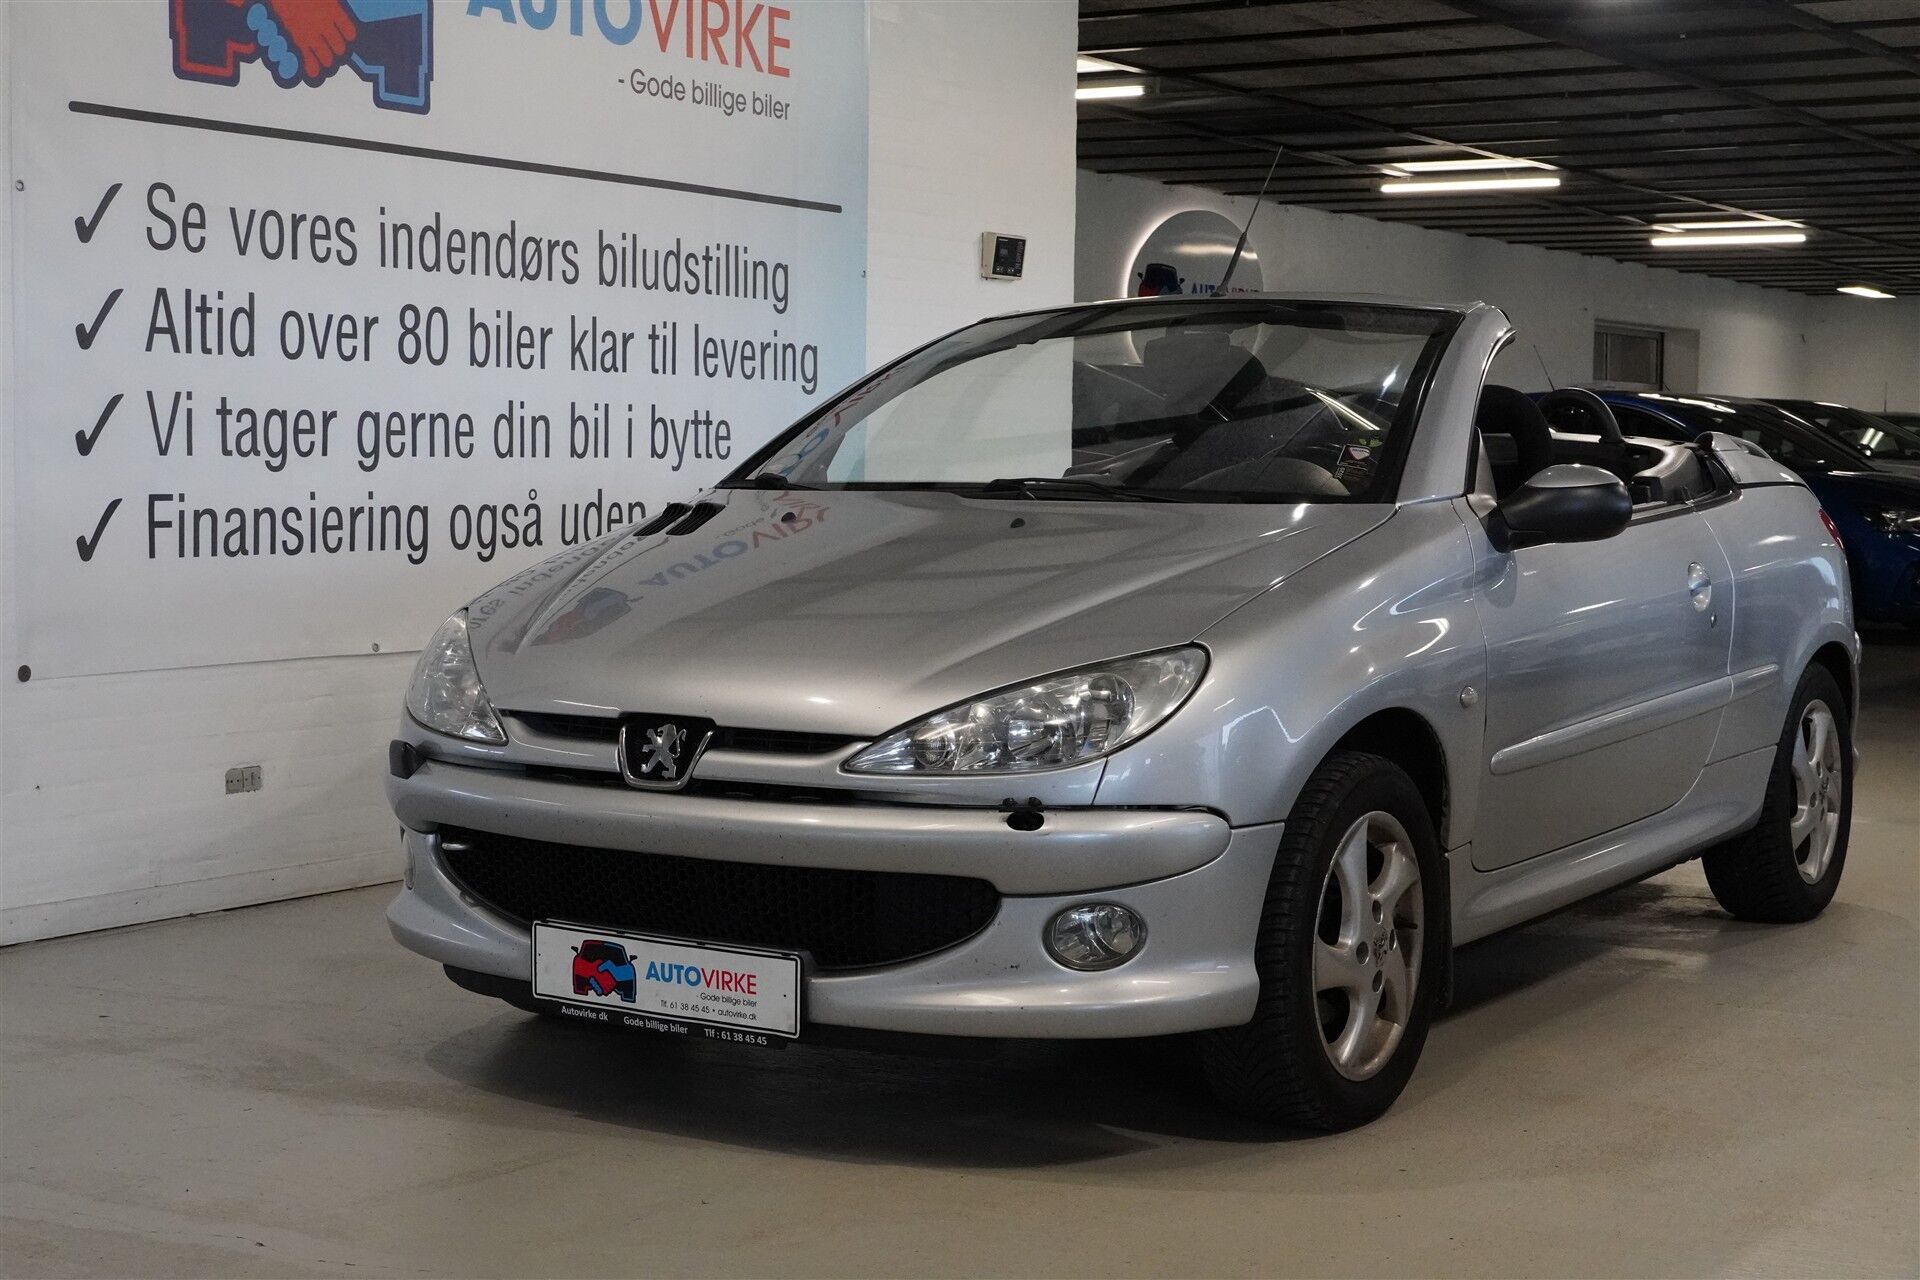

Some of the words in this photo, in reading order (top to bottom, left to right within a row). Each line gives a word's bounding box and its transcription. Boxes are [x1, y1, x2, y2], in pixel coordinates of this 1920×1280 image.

[466, 0, 791, 78] OVIRKE
[631, 69, 686, 101] Gode
[692, 80, 747, 117] billige
[752, 91, 791, 120] biler
[146, 182, 207, 253] Se
[230, 204, 358, 267] vores
[379, 206, 580, 285] indendørs
[598, 229, 789, 315] biludstilling
[145, 288, 255, 357] Altid
[280, 311, 379, 362] over
[397, 304, 449, 366] 80
[469, 314, 553, 370] biler
[570, 315, 635, 374] klar
[647, 321, 677, 376] til
[694, 324, 818, 395] levering
[146, 391, 193, 457] Vi
[215, 396, 337, 473] tager
[357, 410, 475, 473] gerne
[493, 400, 551, 460] din
[569, 402, 610, 460] bil
[627, 403, 634, 459] i
[650, 411, 732, 472] bytte
[147, 491, 429, 565] Finansiering
[449, 488, 543, 563] også
[645, 961, 757, 995] AUTOVIRKE
[561, 1005, 597, 1020] Autovirke
[680, 1003, 689, 1011] 38
[691, 1004, 700, 1012] 45
[700, 992, 721, 1003] Gode
[721, 995, 741, 1007] billige
[742, 998, 757, 1007] biler
[623, 1015, 644, 1028] Gode
[645, 1019, 669, 1032] billige
[670, 1023, 688, 1034] biler
[704, 1028, 715, 1038] Tlf
[721, 1031, 731, 1041] 61
[733, 1032, 743, 1042] 38
[745, 1034, 755, 1043] 45
[756, 1036, 768, 1045] 45
